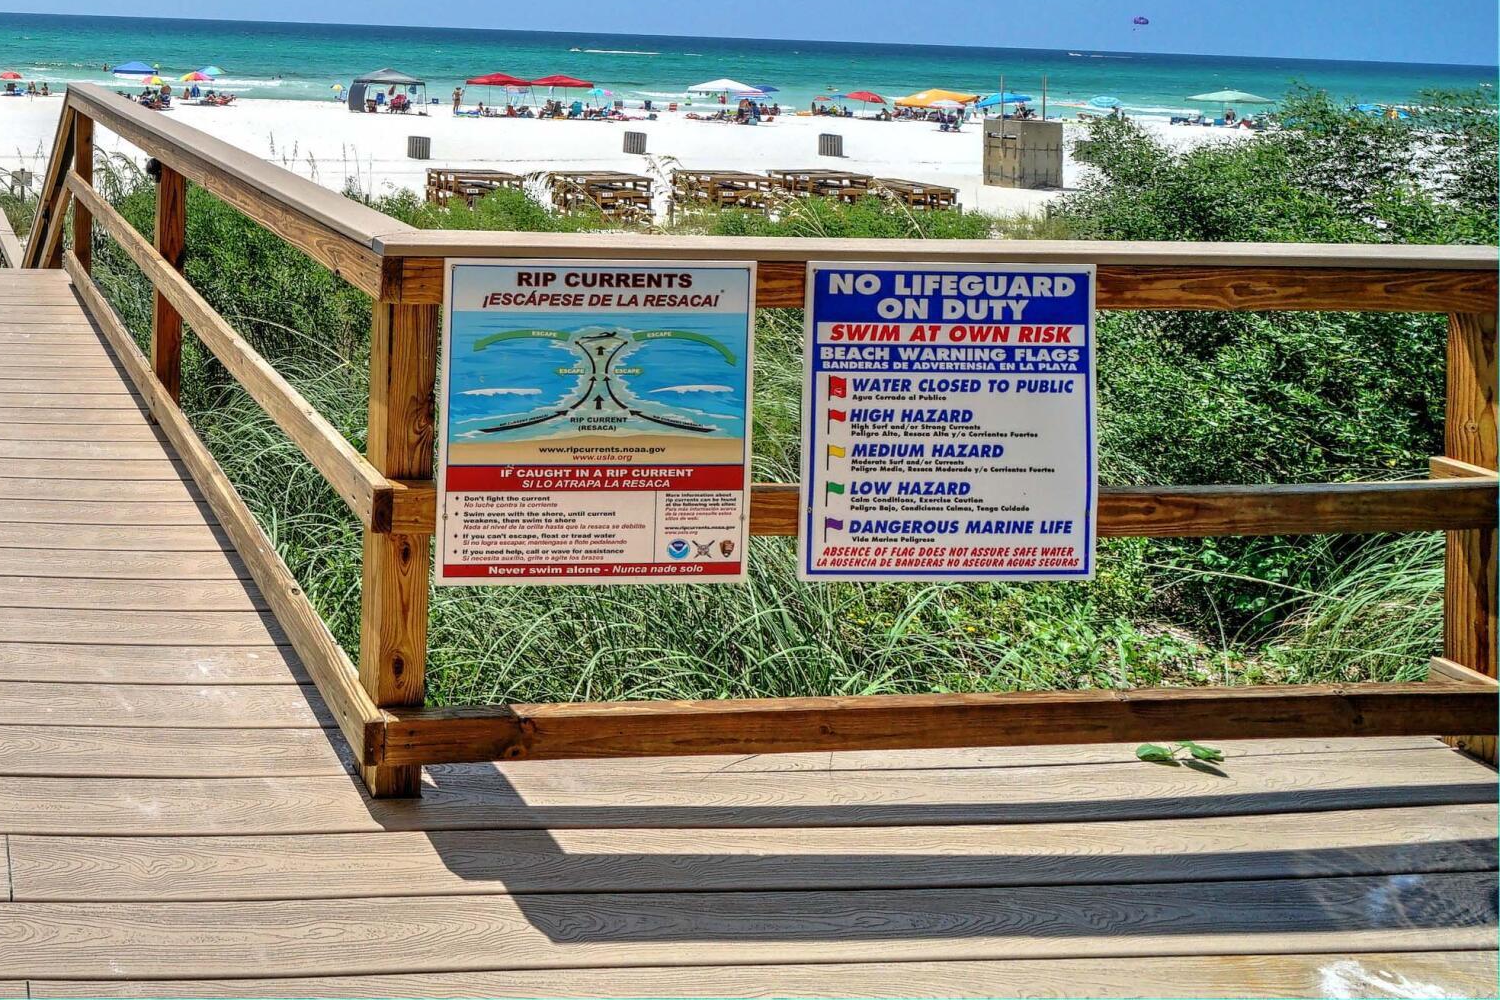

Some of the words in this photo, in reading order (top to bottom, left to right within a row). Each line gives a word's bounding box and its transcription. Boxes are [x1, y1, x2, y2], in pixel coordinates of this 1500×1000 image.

[517, 272, 557, 287] RIP
[564, 272, 693, 288] CURRENTS
[829, 273, 881, 295] NO
[895, 275, 1077, 297] LIFEGUARD
[482, 290, 585, 308] ¡ESCÁPESE
[588, 294, 613, 307] DE
[616, 294, 639, 307] LA
[643, 294, 720, 307] RESACA!
[877, 298, 929, 319] ON
[942, 299, 1030, 321] DUTY
[830, 324, 901, 342] SWIM
[909, 325, 941, 342] AT
[949, 325, 1010, 343] OWN
[1017, 326, 1073, 344] RISK
[820, 346, 890, 362] BEACH
[897, 347, 1007, 362] WARNING
[1014, 348, 1080, 362] FLAGS
[822, 361, 890, 370] BANDERAS
[893, 361, 910, 370] DE
[912, 361, 996, 371] ADVERTENSIA
[999, 362, 1015, 371] EN
[1019, 362, 1035, 372] LA
[1038, 362, 1078, 372] PLAYA
[852, 378, 912, 392] WATER
[918, 379, 982, 393] CLOSED
[988, 379, 1010, 393] TO
[1015, 379, 1074, 393] PUBLIC
[852, 394, 873, 402] Agua
[849, 408, 895, 425] HIGH
[900, 409, 973, 425] HAZARD
[578, 424, 617, 432] (RESACA)
[851, 423, 870, 432] High
[872, 423, 888, 432] Surf
[887, 423, 918, 432] and/or
[921, 424, 946, 432] Strong
[949, 424, 981, 432] Currents
[851, 429, 879, 438] Peligro
[882, 430, 901, 438] Alto,
[933, 429, 949, 437] Alta
[538, 446, 666, 454] www.ripcurrents.noaa.gov
[851, 443, 924, 460] MEDIUM
[931, 444, 1004, 458] HAZARD
[572, 454, 633, 462] www.usla.org
[500, 469, 514, 478] IF
[516, 469, 572, 478] CAUGHT
[575, 469, 589, 477] IN
[593, 469, 602, 477] A
[606, 469, 628, 477] RIP
[631, 469, 694, 477] CURRENT
[522, 479, 534, 488] SI
[536, 479, 553, 488] LO
[554, 479, 601, 488] ATRAPA
[604, 479, 619, 488] LA
[622, 479, 670, 488] RESACA
[850, 481, 892, 495] LOW
[897, 481, 971, 496] HAZARD
[872, 496, 916, 504] Conditions,
[849, 520, 959, 534] DANGEROUS
[965, 520, 1034, 534] MARINE
[1039, 520, 1073, 534] LIFE
[822, 546, 872, 557] ABSENCE
[874, 547, 889, 557] OF
[890, 547, 916, 557] FLAG
[918, 547, 947, 557] DOES
[948, 547, 969, 557] NOT
[970, 547, 1011, 557] ASSURE
[1012, 547, 1038, 557] SAFE
[1040, 546, 1074, 557] WATER
[816, 558, 828, 567] LA
[829, 558, 877, 567] AUSENCIA
[879, 558, 893, 567] DE
[894, 558, 945, 567] BANDERAS
[946, 558, 960, 567] NO
[962, 558, 1005, 567] ASEGURA
[1006, 558, 1037, 567] AGUAS
[1038, 558, 1080, 567] SEGURAS
[488, 566, 526, 575] Never
[529, 565, 562, 574] swim
[566, 565, 601, 574] alone
[612, 565, 648, 573] Nunca
[650, 564, 677, 573] nade
[679, 564, 704, 573] solo
